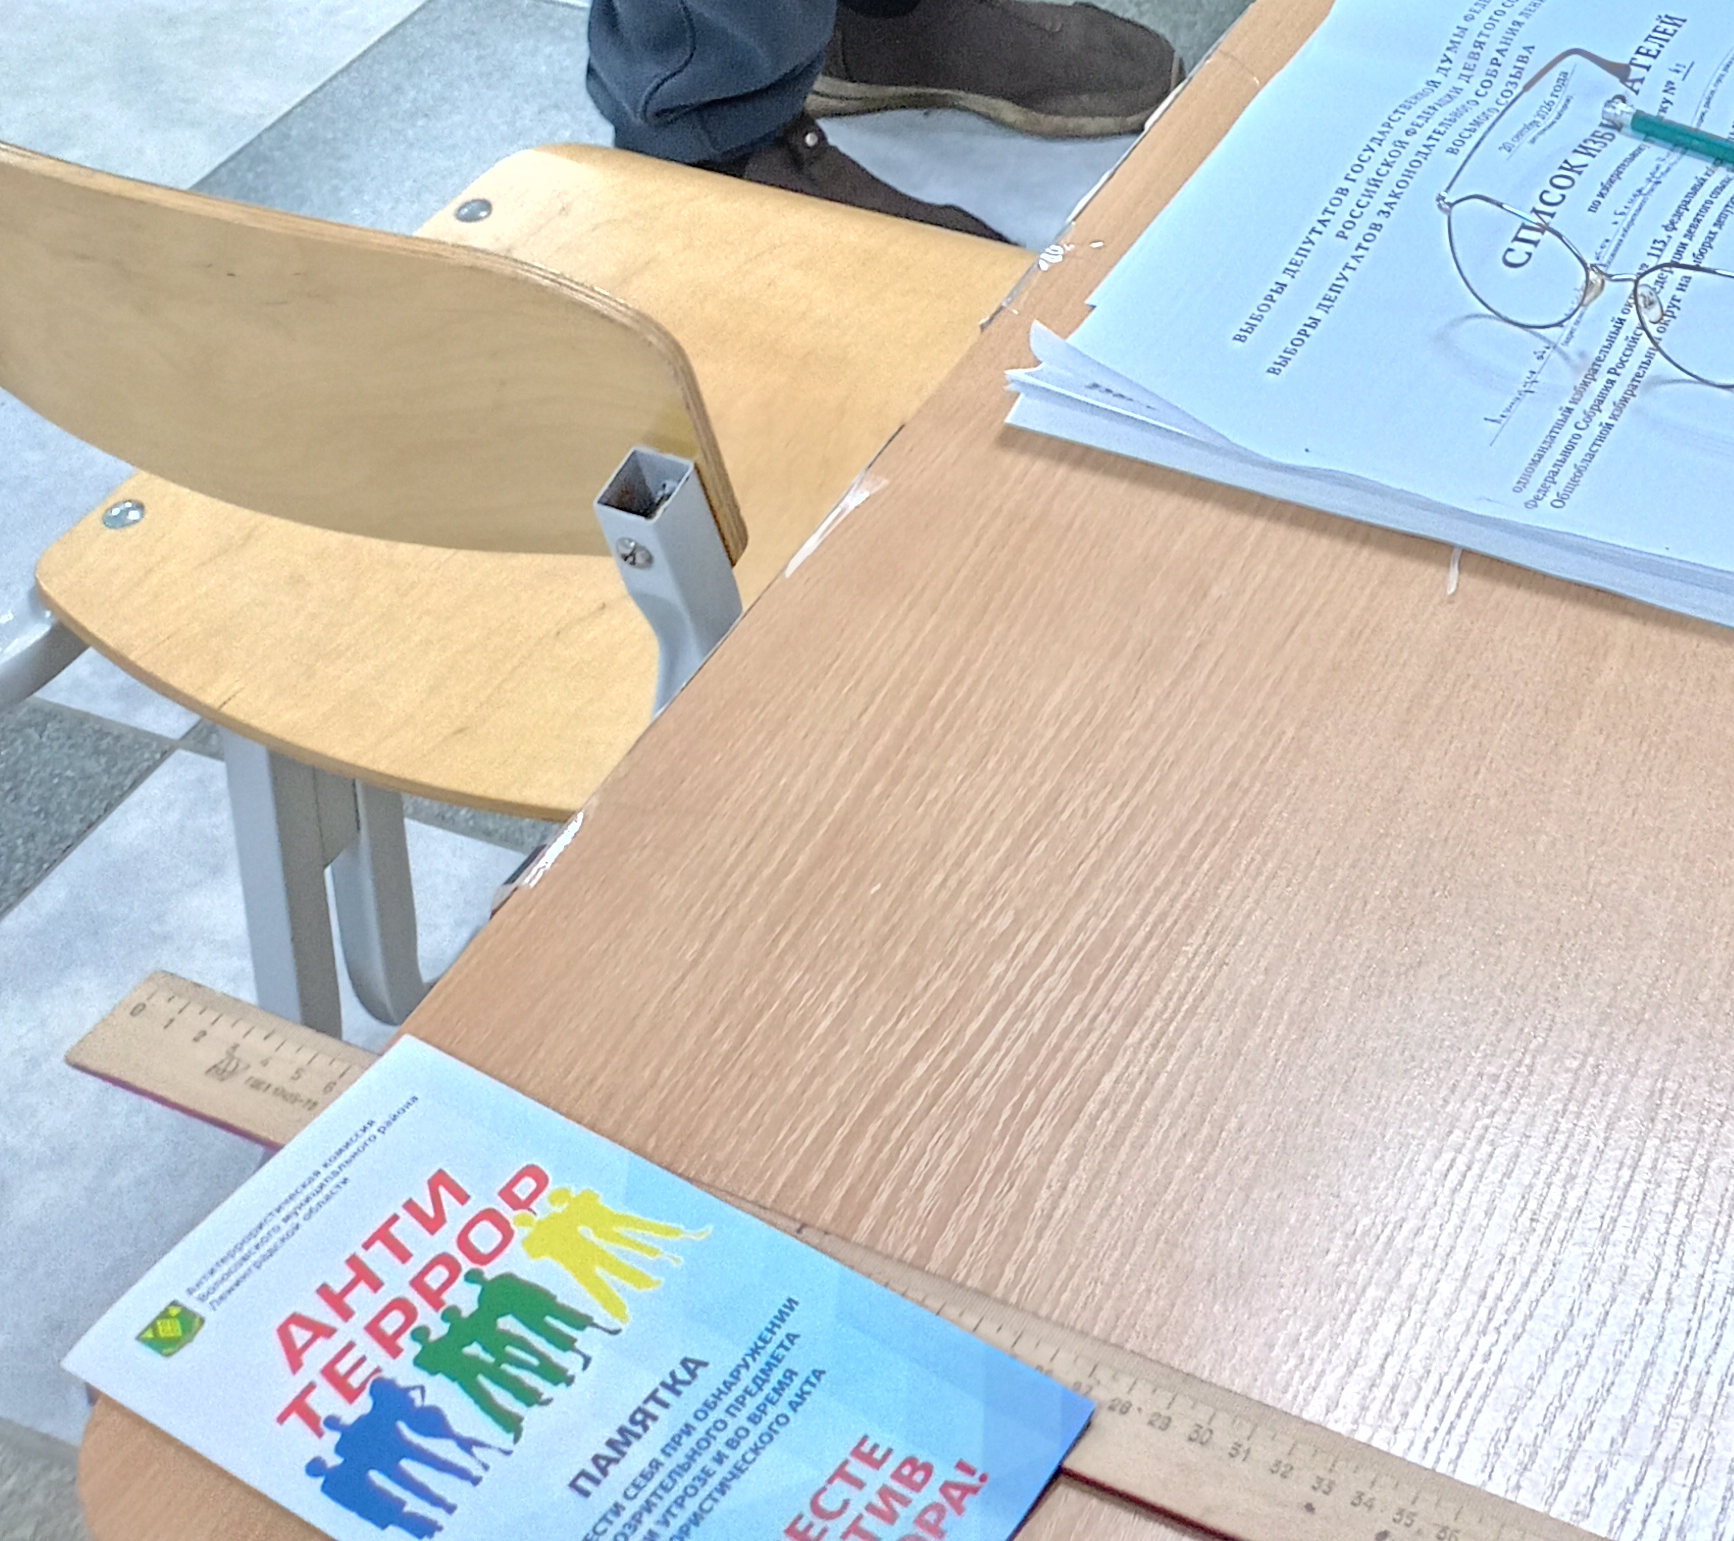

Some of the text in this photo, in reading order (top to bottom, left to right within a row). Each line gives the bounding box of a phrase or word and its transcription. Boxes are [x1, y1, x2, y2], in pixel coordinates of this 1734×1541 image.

[1334, 139, 1407, 241] РОССИЙСКОЙ
[1404, 85, 1464, 137] ФЕДЕРАЦИИ
[1458, 9, 1506, 84] ДЕВЯТОГО
[1444, 45, 1536, 156] ВОСЬМОГО СОЗЫВА
[1549, 70, 1569, 99] года
[1587, 199, 1602, 214] по
[1662, 79, 1677, 96] №
[1232, 280, 1287, 344] ВЫБОРЫ
[1282, 186, 1350, 280] ДЕПУТАТОВ
[1343, 79, 1441, 184] ГОСУДАРСТВЕННОЙ
[1437, 25, 1468, 78] ДУМЫ
[1265, 315, 1321, 376] ВЫБОРЫ
[1316, 222, 1384, 315] ДЕПУТАТОВ
[1376, 99, 1479, 219] ЗАКОНОДАТЕЛЬНОГО
[1474, 19, 1525, 98] СОБРАНИЯ
[1501, 158, 1588, 269] СПИСОК
[1512, 405, 1574, 494] одномандатный
[1568, 316, 1627, 406] избирательный
[1620, 287, 1640, 315] окр
[1662, 175, 1708, 233] федеральный
[1523, 432, 1581, 510] Федерального
[1573, 377, 1617, 432] Собрания
[1606, 322, 1646, 377] Российск
[1682, 195, 1715, 241] девятого
[1549, 421, 1614, 509] Общеобластной
[1655, 296, 1680, 335] округ
[1675, 275, 1692, 293] на
[1691, 229, 1719, 267] ыборах
[185, 1119, 376, 1296] Антитеррористическая комиссия
[196, 1095, 419, 1303] Волосовского муниципального района
[208, 1176, 350, 1311] Ленинградской области
[275, 1167, 471, 1376] АНТИ
[274, 1165, 549, 1440] ТЕРРОР
[786, 1367, 827, 1415] АКТА
[568, 1355, 710, 1499] ПАМЯТКА
[612, 1330, 801, 1541] ОЗРИТЕЛЬНОГО ПРЕДМЕТА
[622, 1457, 666, 1501] СЕБЯ
[659, 1421, 697, 1459] ПРИ
[692, 1296, 800, 1423] ОБНАРУЖЕНИИ
[656, 1366, 799, 1529] УГРОЗЕ И ВО ВРЕМЯ
[783, 1433, 894, 1541] ЕСТЕ
[1186, 1422, 1214, 1447] 30
[839, 1455, 935, 1541] ТИВ
